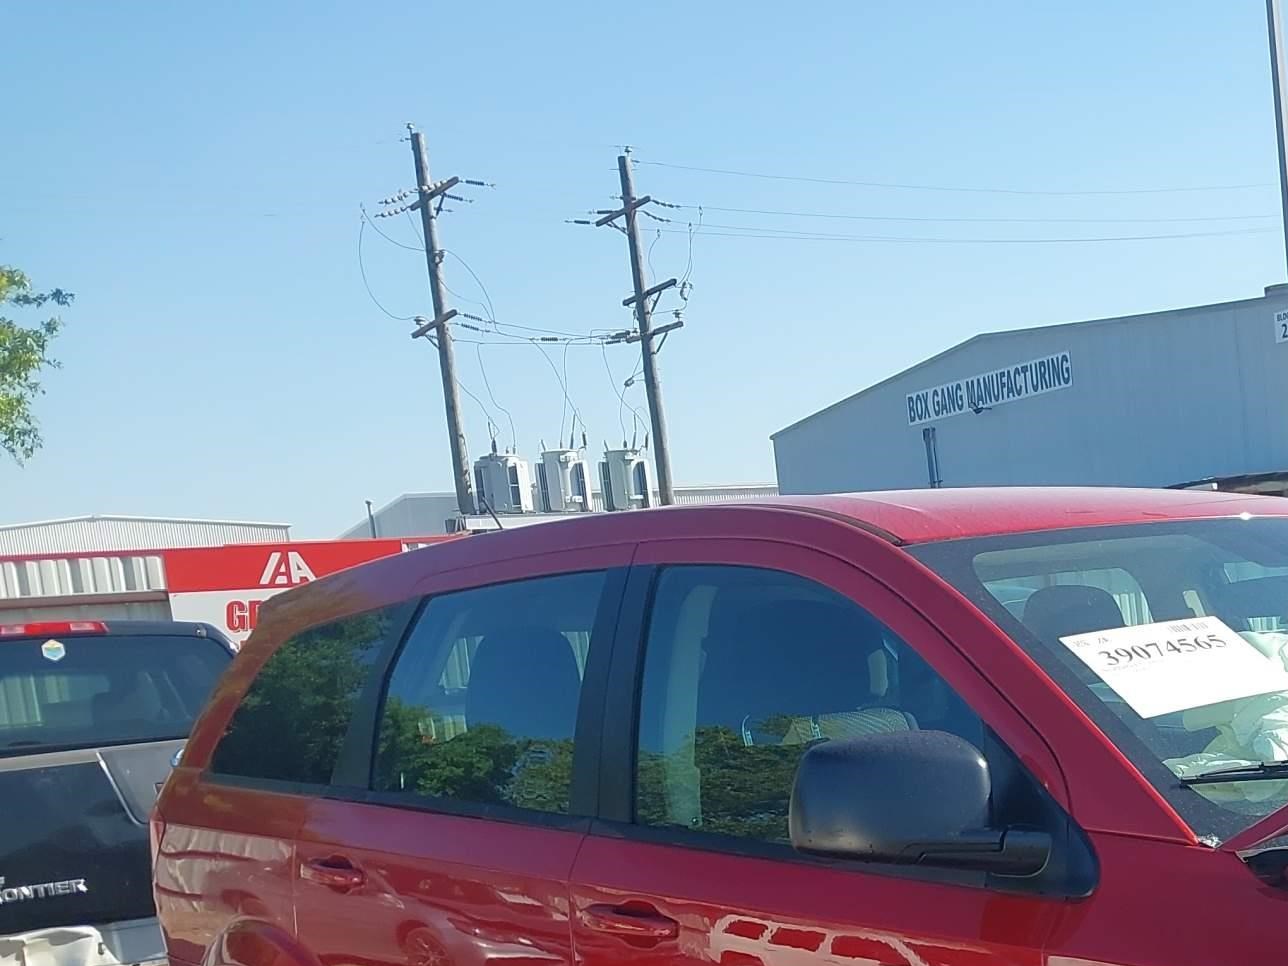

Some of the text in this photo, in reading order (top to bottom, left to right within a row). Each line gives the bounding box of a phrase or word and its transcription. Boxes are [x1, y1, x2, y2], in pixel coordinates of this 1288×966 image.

[1282, 324, 1288, 338] 2
[907, 354, 1071, 423] BOX GANG MANUFACTURING
[1098, 634, 1227, 666] 39074565
